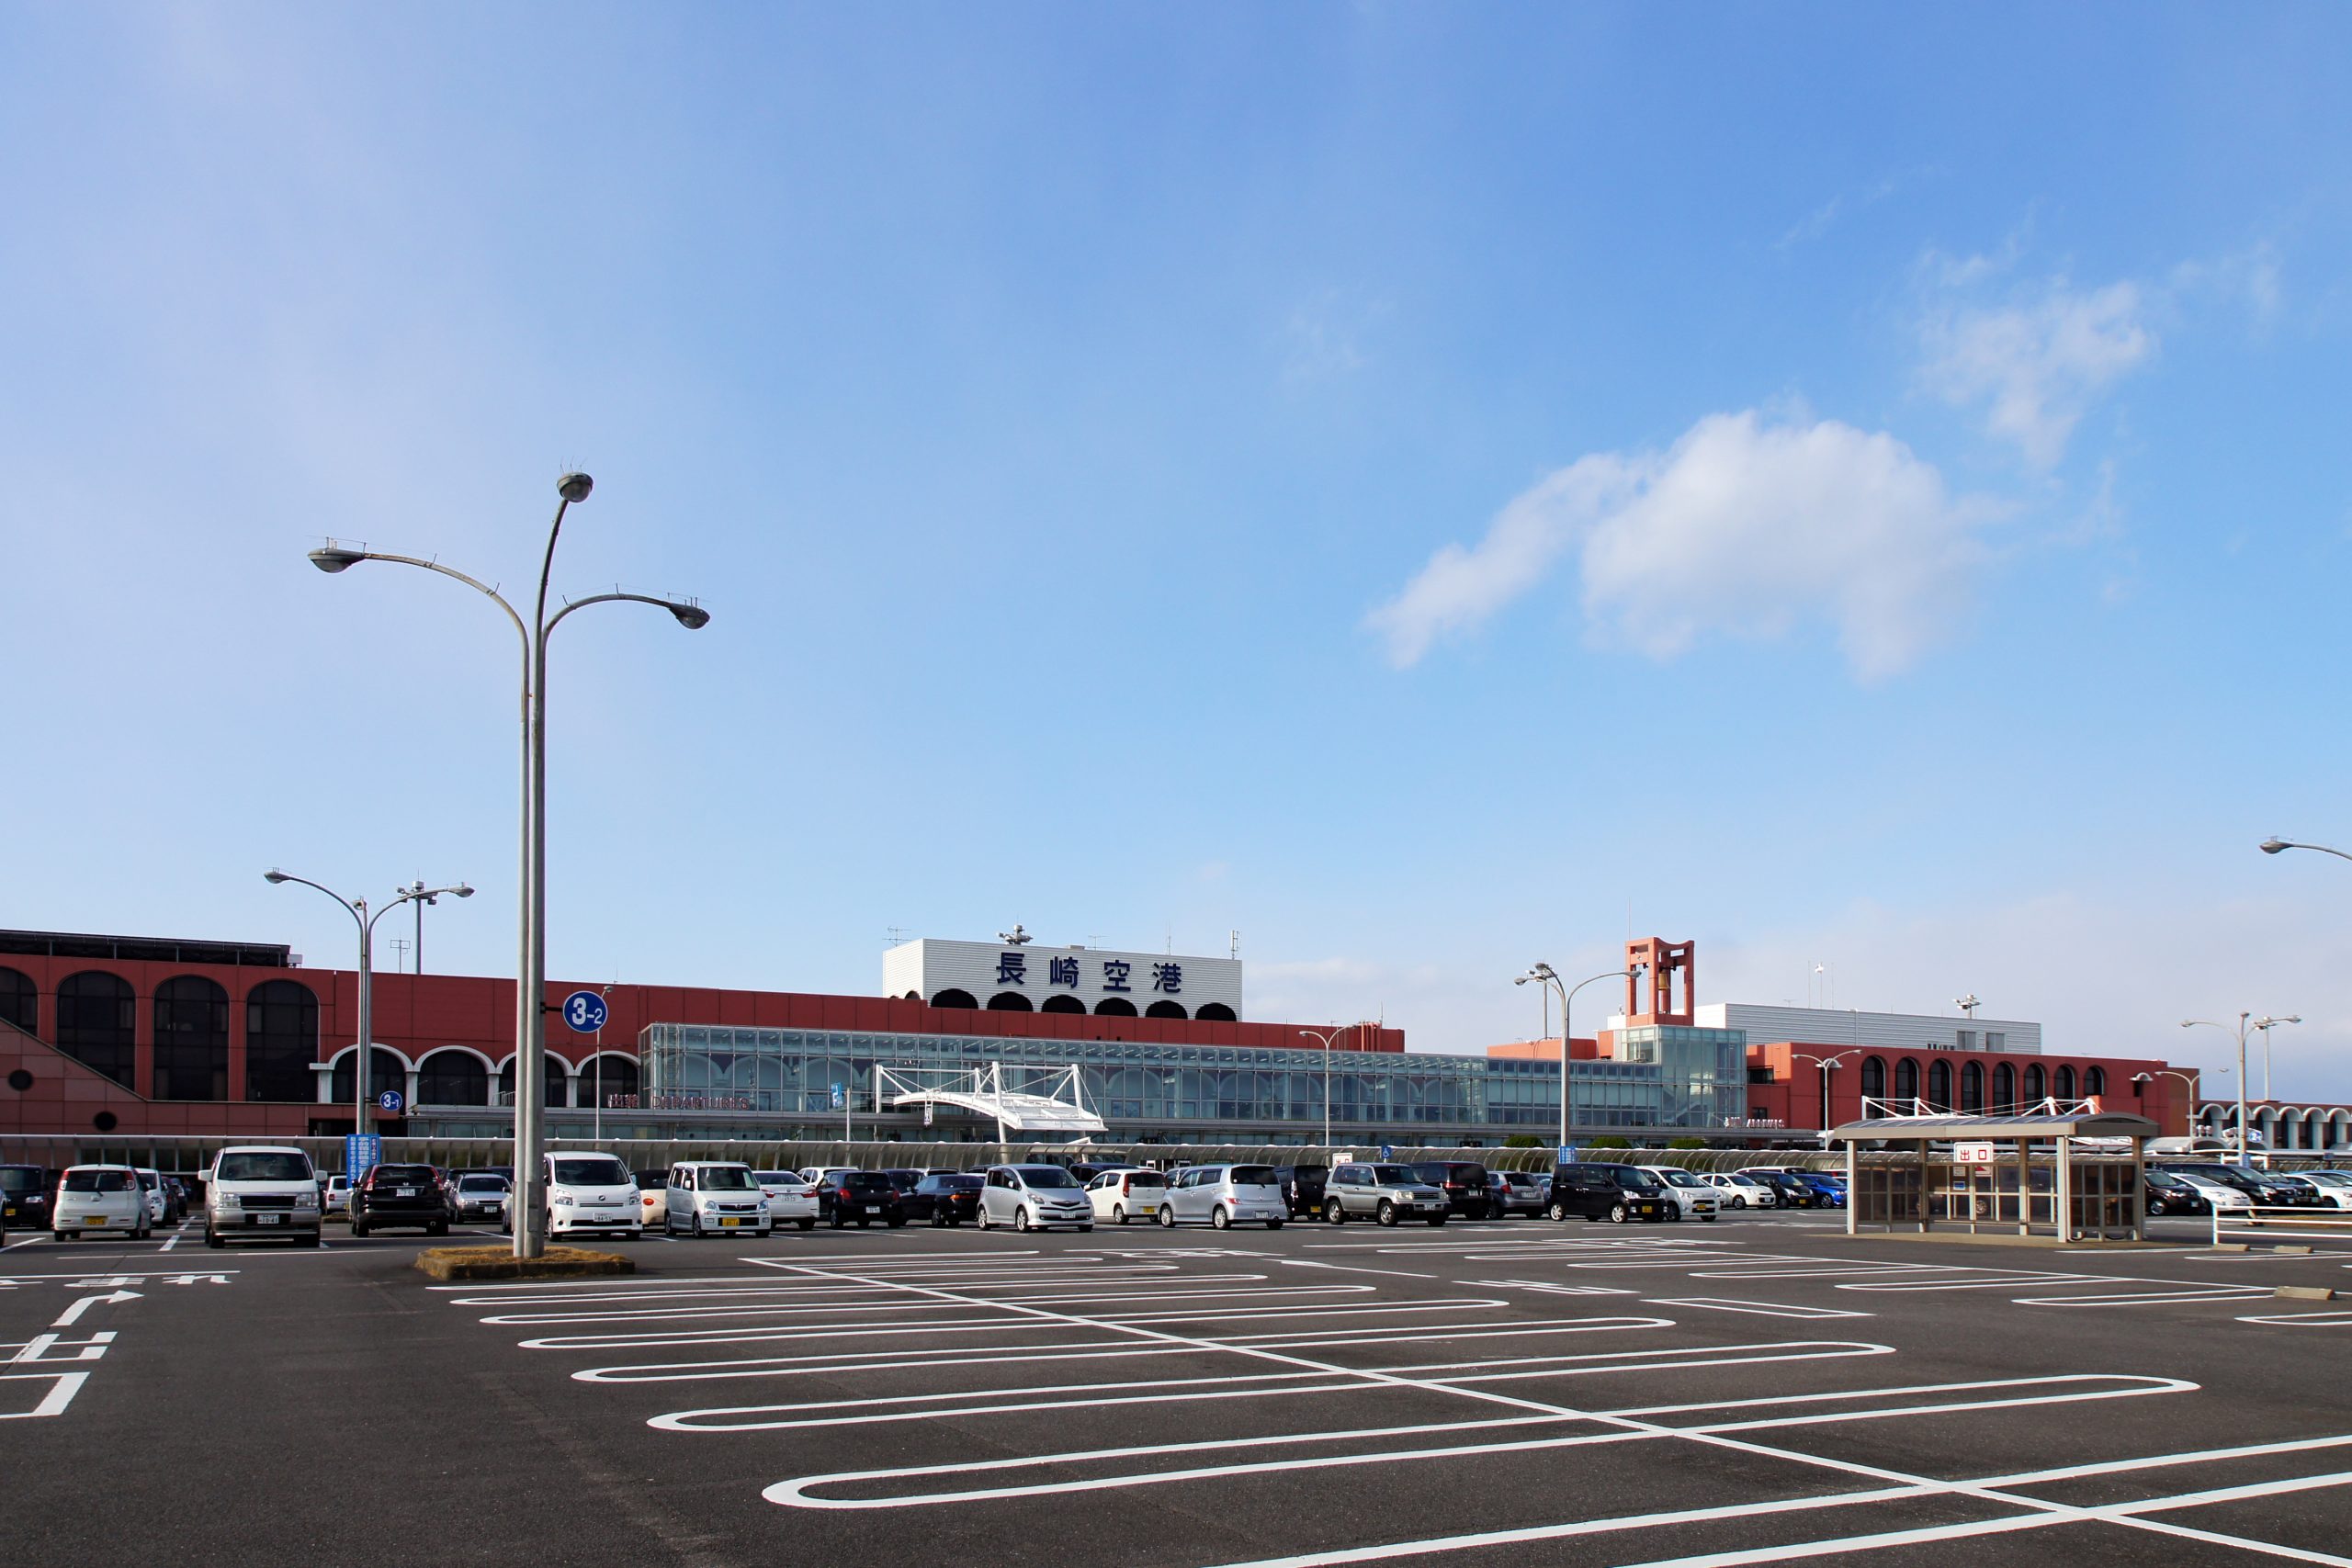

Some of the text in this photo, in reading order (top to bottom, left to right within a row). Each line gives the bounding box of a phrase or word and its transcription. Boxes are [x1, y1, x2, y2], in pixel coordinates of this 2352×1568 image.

[995, 952, 1182, 994] 長崎空港
[571, 997, 603, 1026] 3-2
[383, 1094, 400, 1108] 3-1
[651, 1096, 750, 1110] DEPARTURES
[1960, 1149, 1987, 1161] 出口
